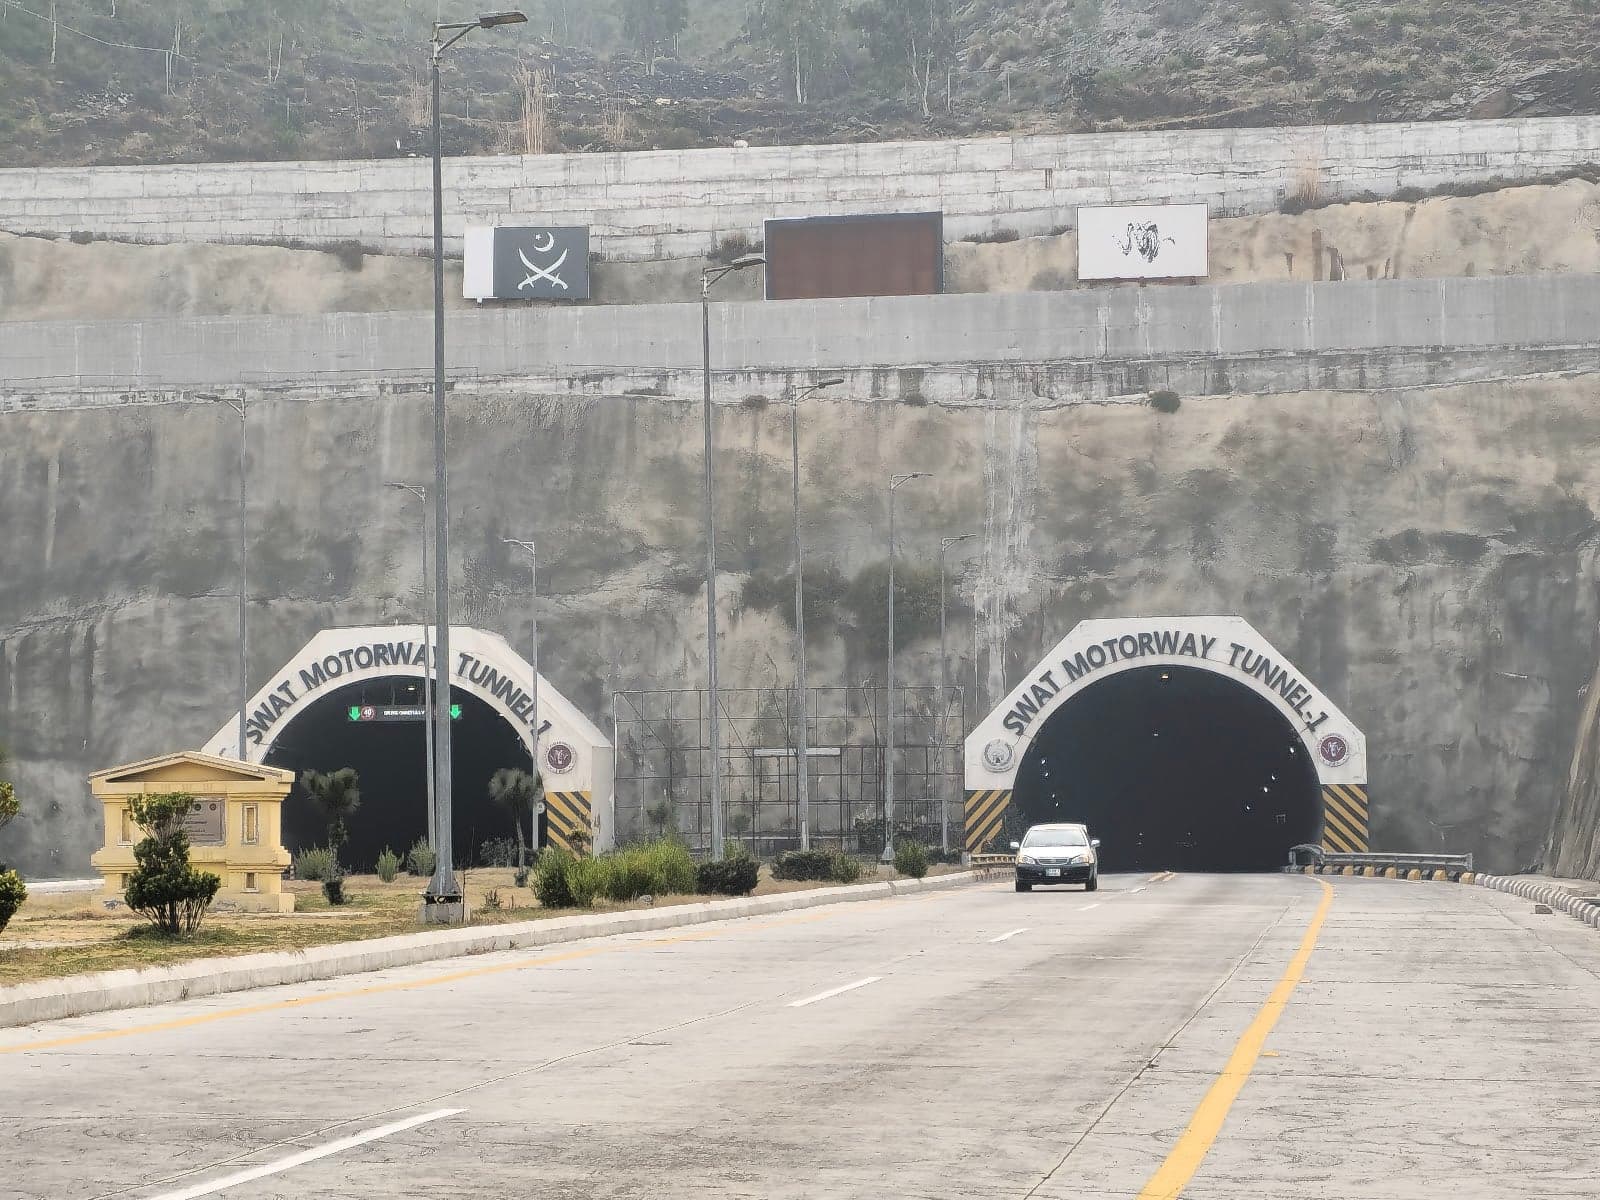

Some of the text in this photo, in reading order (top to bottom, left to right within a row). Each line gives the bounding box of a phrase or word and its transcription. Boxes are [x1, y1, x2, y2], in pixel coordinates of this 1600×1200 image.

[245, 679, 299, 745] SWAT
[299, 641, 437, 691] MOTORWA
[1003, 630, 1329, 736] SWAT MOTORWAY TUNNEL-1
